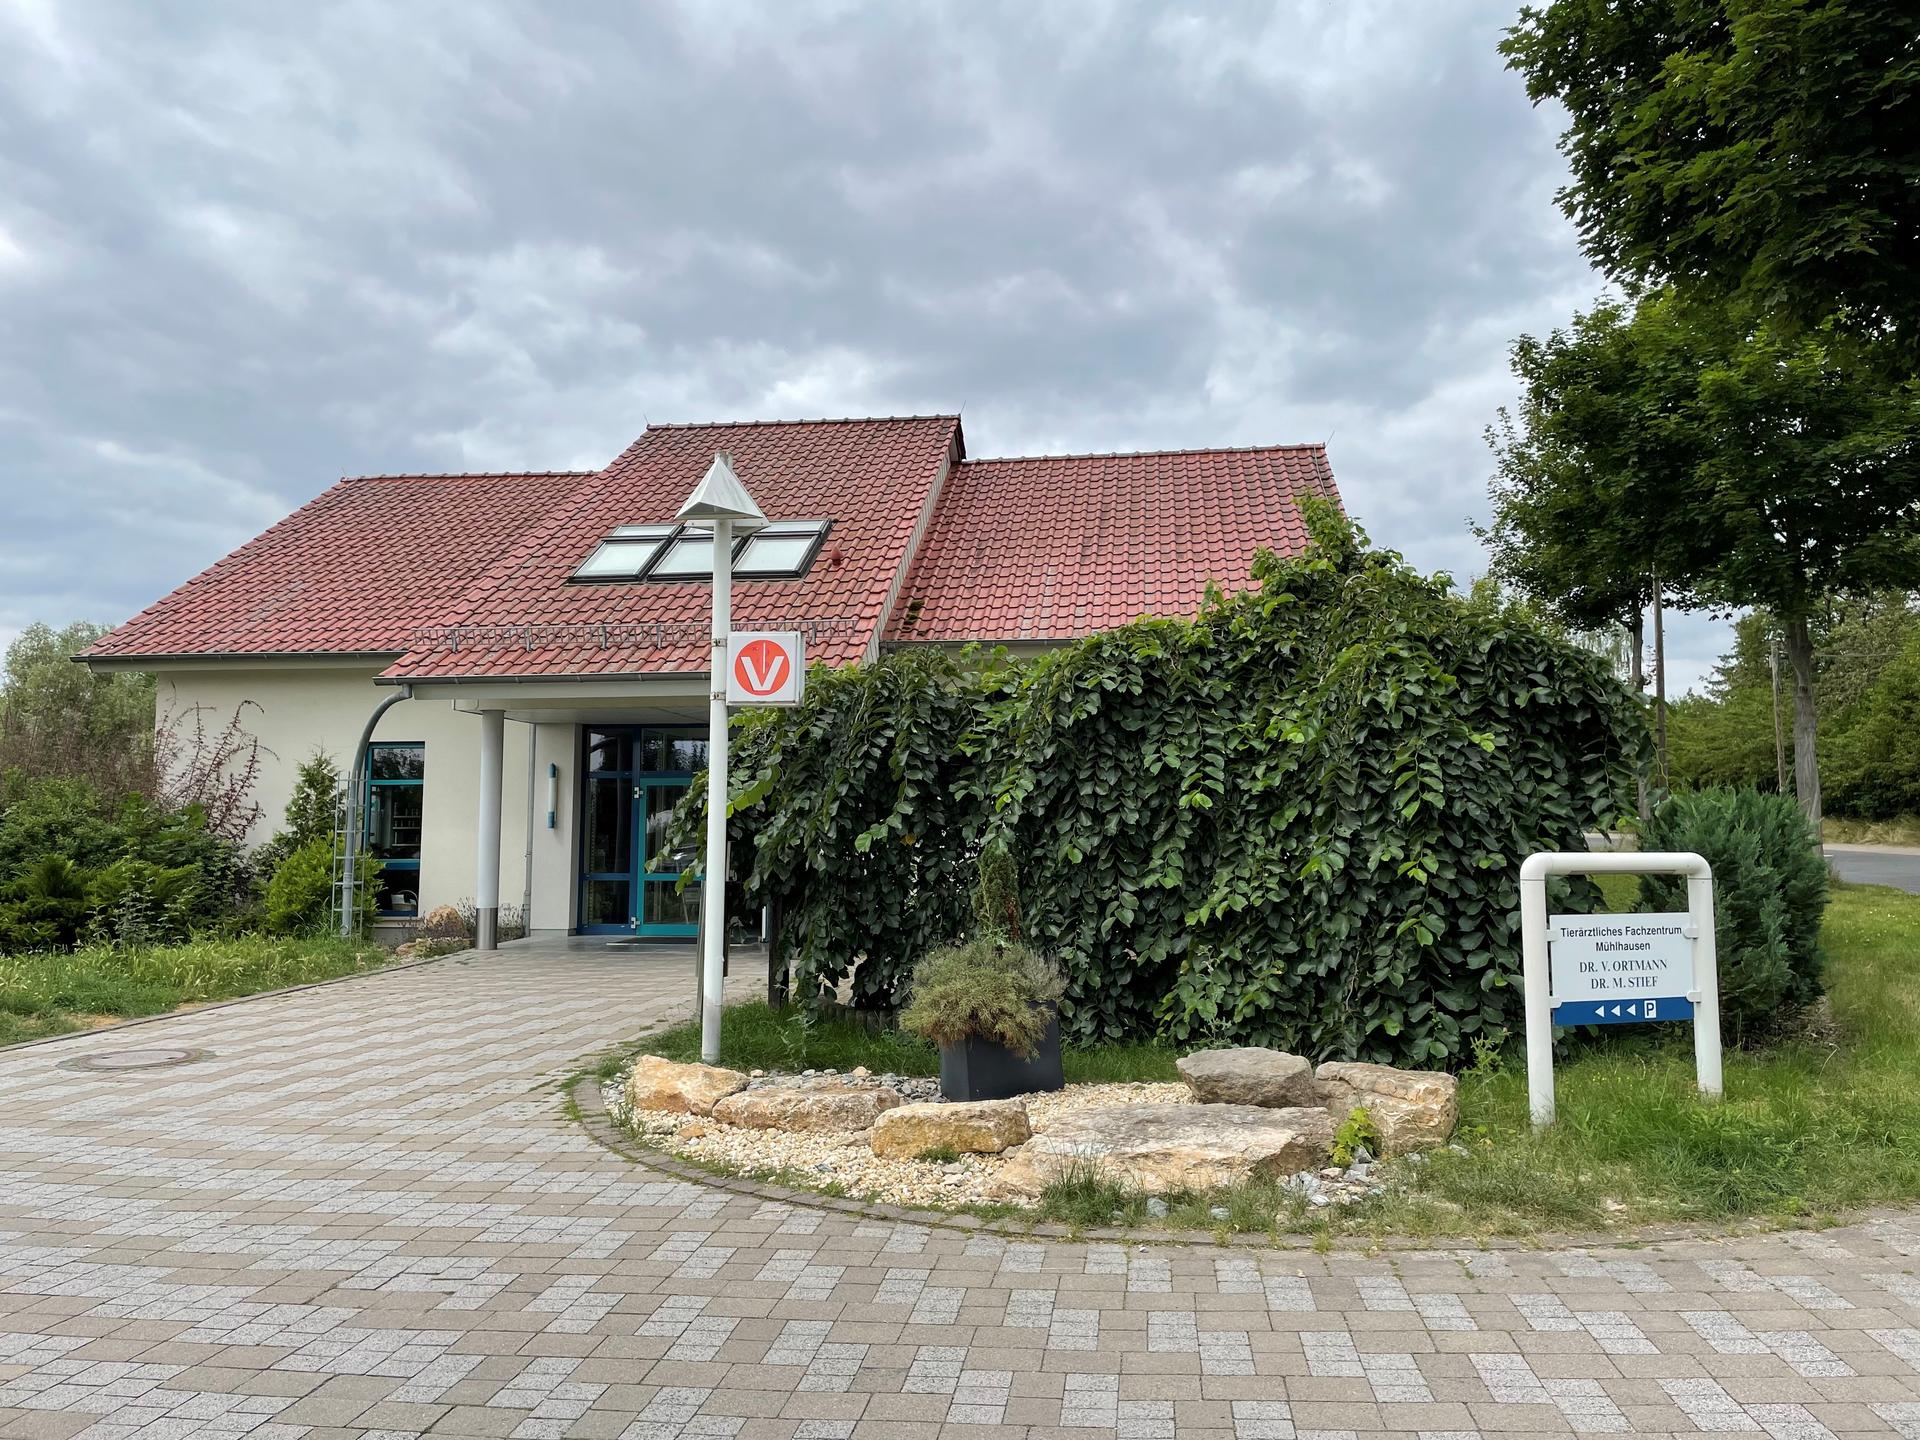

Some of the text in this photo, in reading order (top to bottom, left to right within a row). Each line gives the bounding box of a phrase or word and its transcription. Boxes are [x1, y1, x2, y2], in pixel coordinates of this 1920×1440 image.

[1560, 925, 1682, 938] Tierärztliches Fachzentrum
[1595, 941, 1651, 952] Mühlhausen
[1579, 961, 1598, 973] DR.
[1591, 978, 1610, 990] DR.
[1646, 1002, 1655, 1017] P
